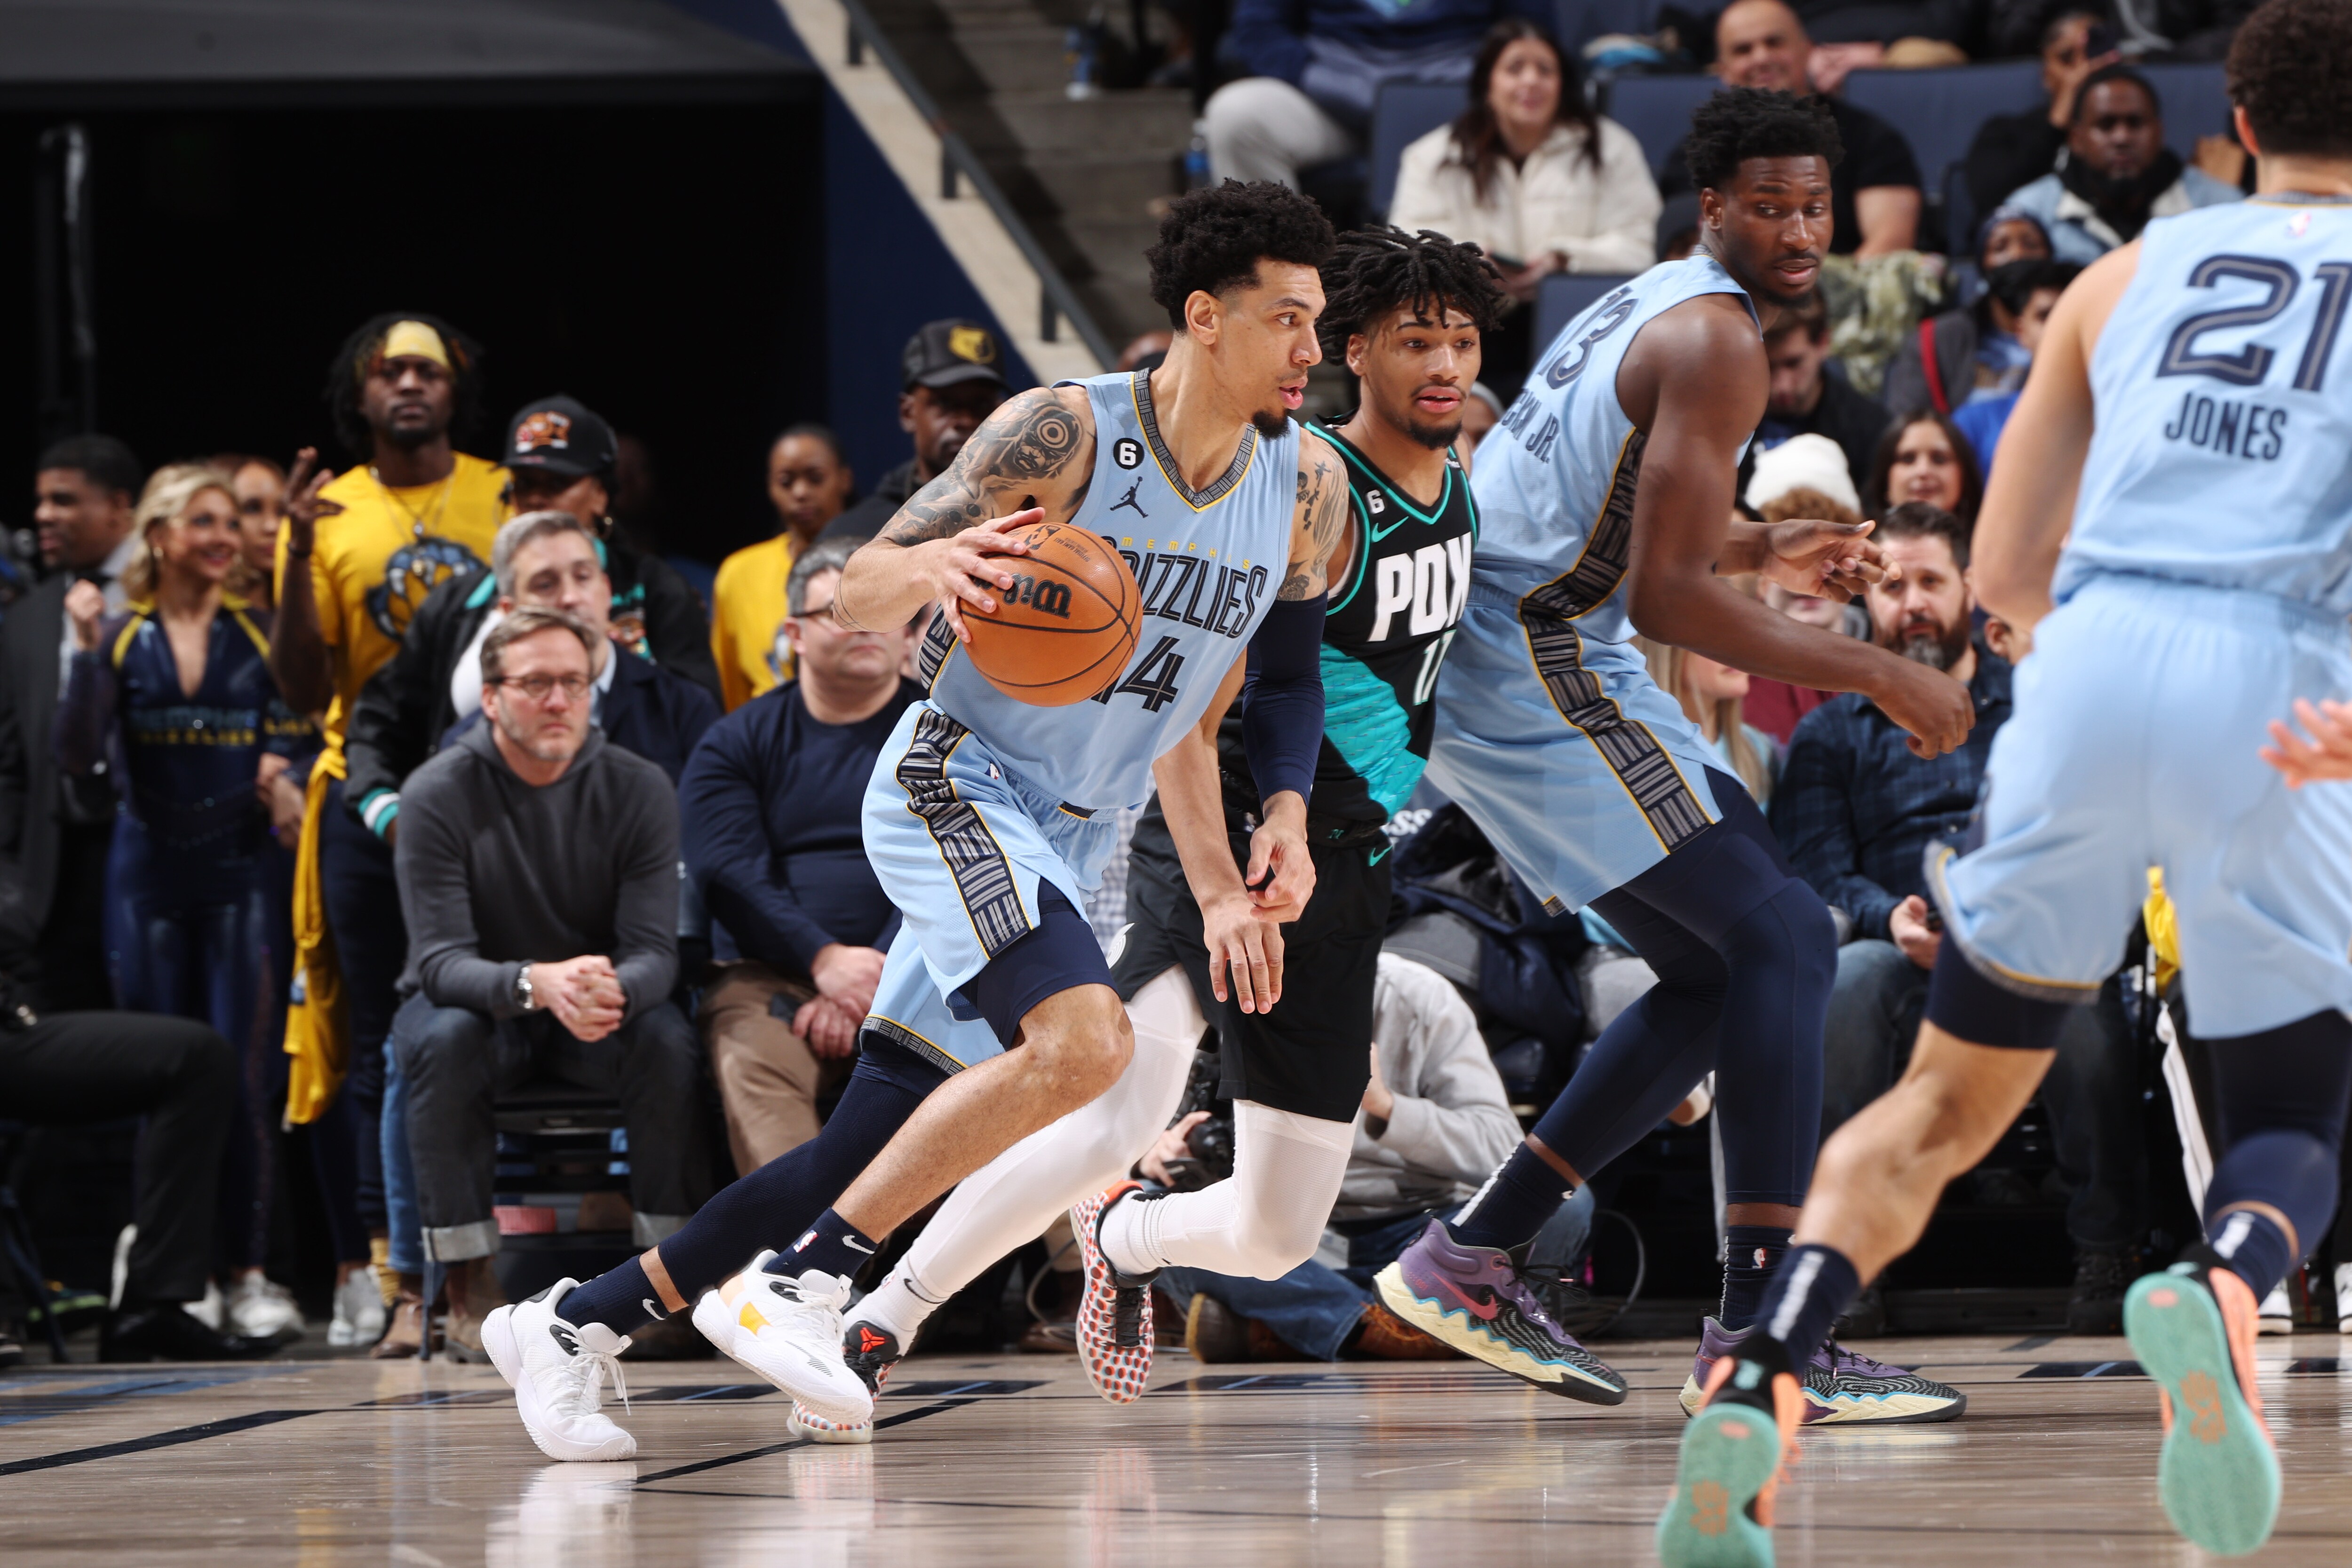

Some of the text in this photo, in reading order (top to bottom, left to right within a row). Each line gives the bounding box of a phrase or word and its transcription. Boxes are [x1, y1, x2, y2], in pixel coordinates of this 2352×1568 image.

[1538, 285, 1639, 390] 13
[2155, 254, 2352, 392] 21
[1120, 442, 1136, 466] 6
[2164, 392, 2288, 461] JONES
[1366, 489, 1385, 514] 6
[1121, 537, 1250, 570] MEMPHIS
[1367, 531, 1471, 642] PDX
[1091, 635, 1185, 713] 4
